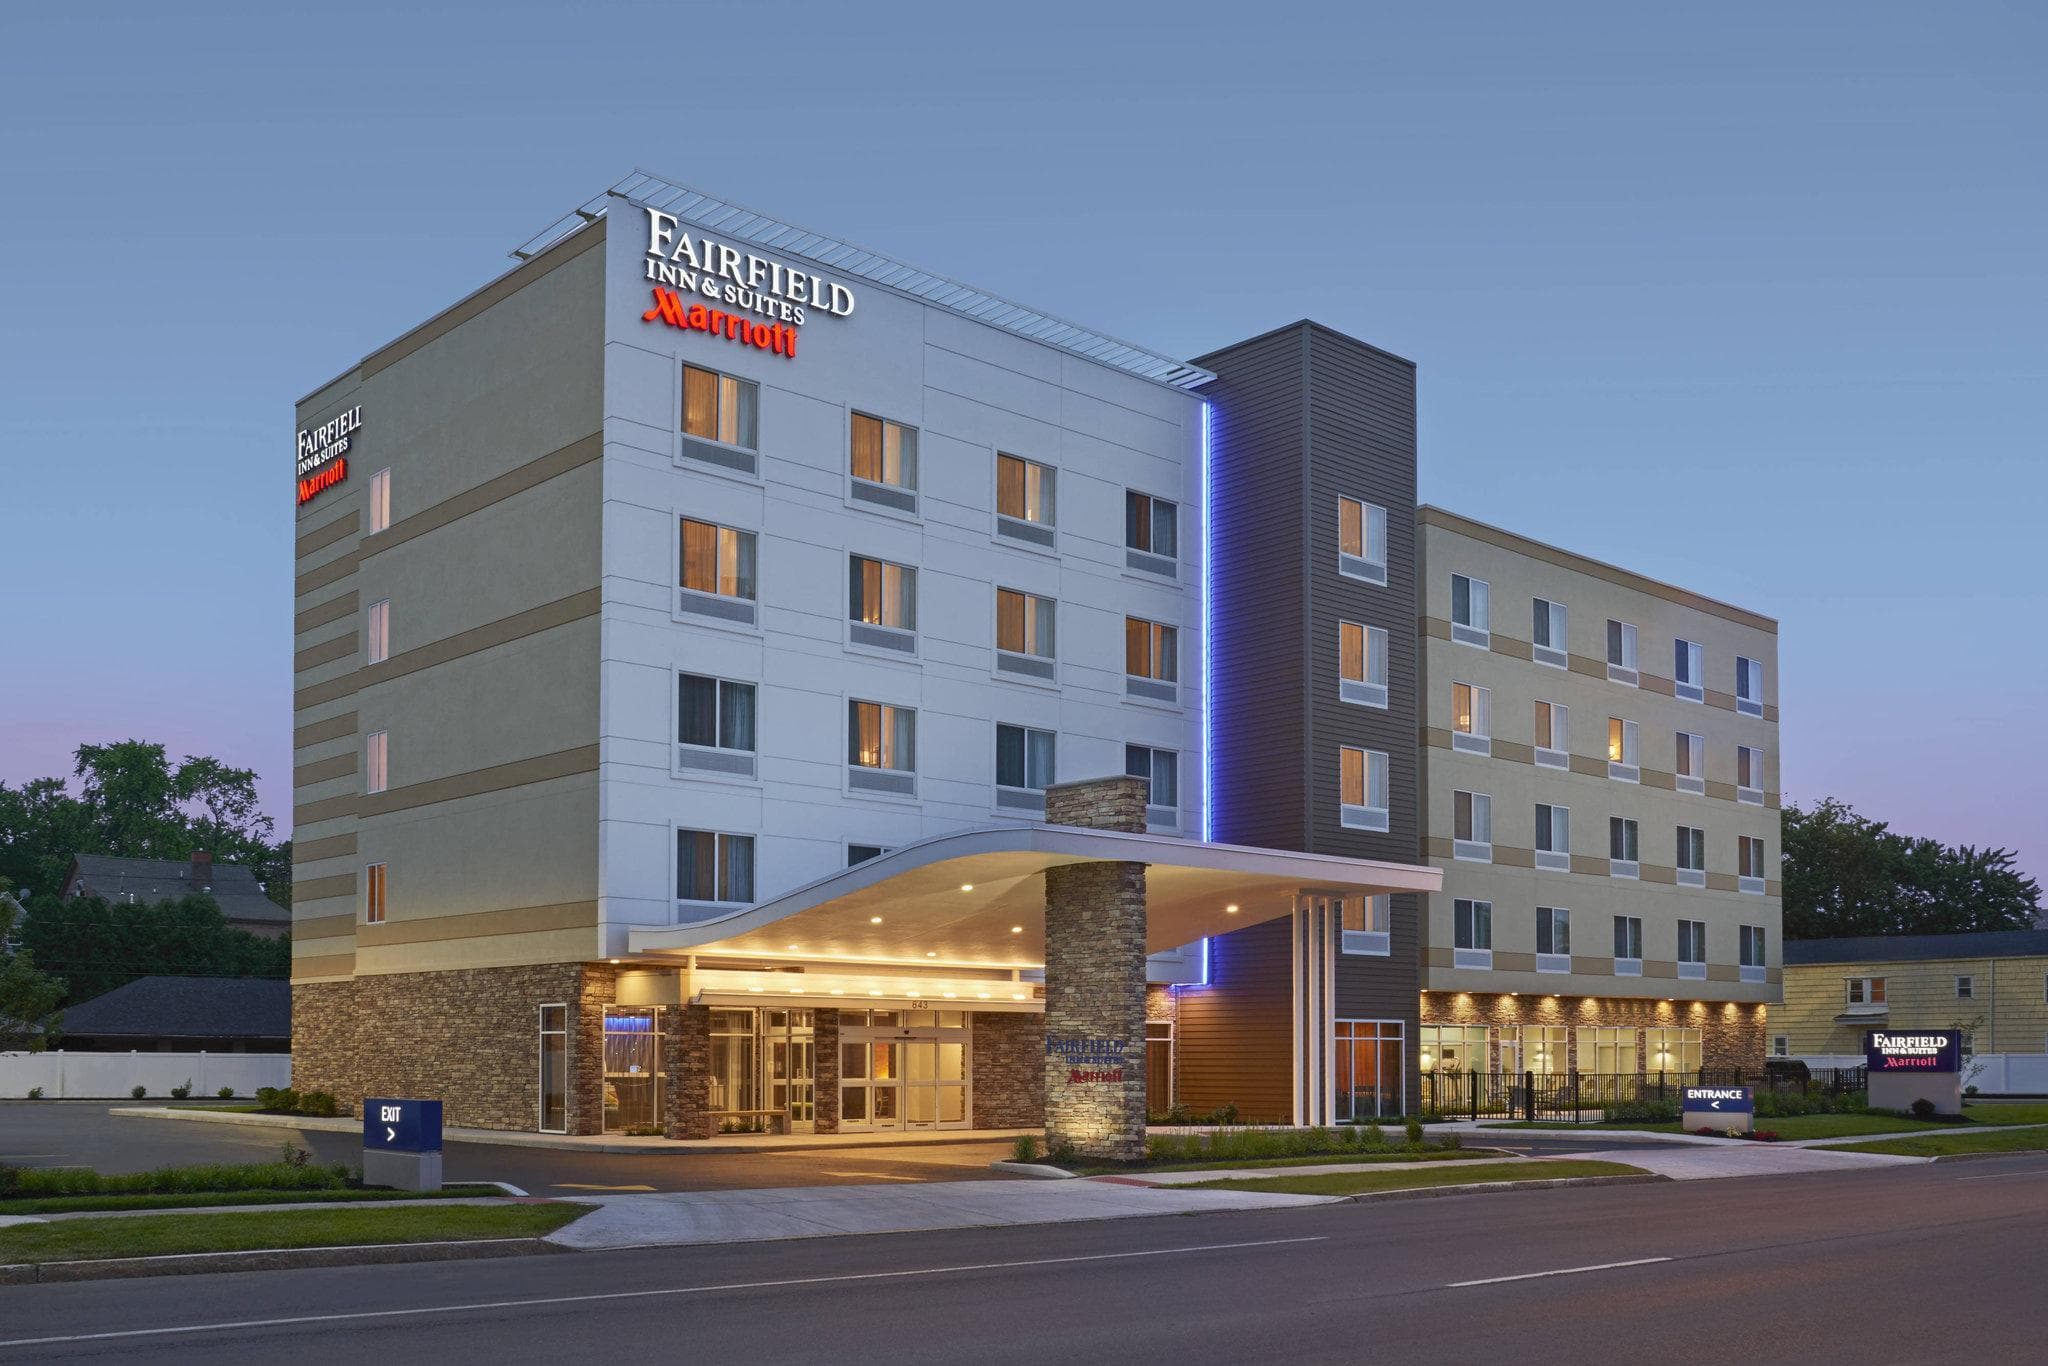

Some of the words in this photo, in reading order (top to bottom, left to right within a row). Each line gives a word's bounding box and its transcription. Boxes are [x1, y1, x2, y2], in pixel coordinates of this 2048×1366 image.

[646, 207, 855, 317] FAIRFIELD
[646, 257, 699, 293] INN
[701, 277, 722, 300] &
[724, 285, 806, 326] SUITES
[641, 286, 798, 359] Marriott
[298, 457, 314, 476] INN
[313, 452, 321, 467] &
[320, 436, 349, 463] SUITES
[297, 456, 346, 506] Marriott
[1045, 1034, 1126, 1057] FAIRFIELD
[1873, 1032, 1948, 1049] FAIRFIELD
[1882, 1047, 1899, 1055] INN
[1907, 1047, 1938, 1055] SUITES
[1884, 1056, 1938, 1068] Marriott
[1687, 1089, 1743, 1100] ENTRANCE
[381, 1105, 402, 1123] EXIT
